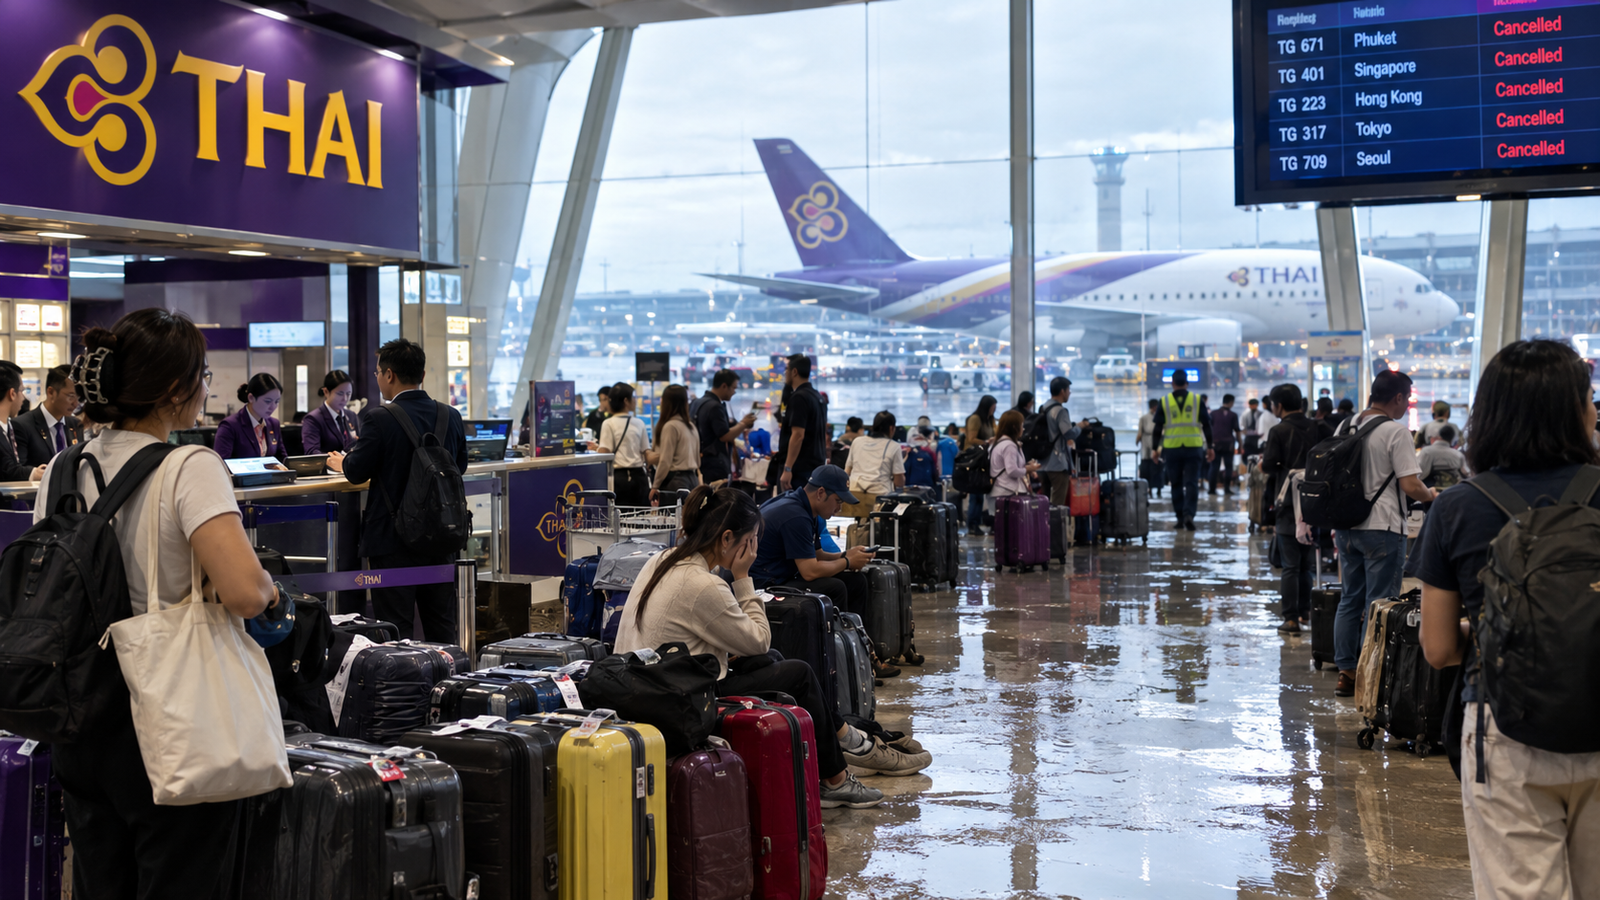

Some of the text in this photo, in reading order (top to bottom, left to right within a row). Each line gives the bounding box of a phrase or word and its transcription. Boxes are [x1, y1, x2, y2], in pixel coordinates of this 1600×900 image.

[1278, 15, 1562, 55] TG 671 Phuket Cancelled
[1278, 46, 1563, 84] TG 401 Singapore Cancelled
[1278, 77, 1564, 113] TG 223 Hong Kong Cancelled
[171, 50, 384, 189] THAI
[1279, 108, 1564, 142] TG 317 Tokyo Cancelled
[1279, 139, 1565, 171] TG 709 Seoul Cancelled
[1254, 266, 1318, 284] THAI
[363, 574, 382, 585] THAI
